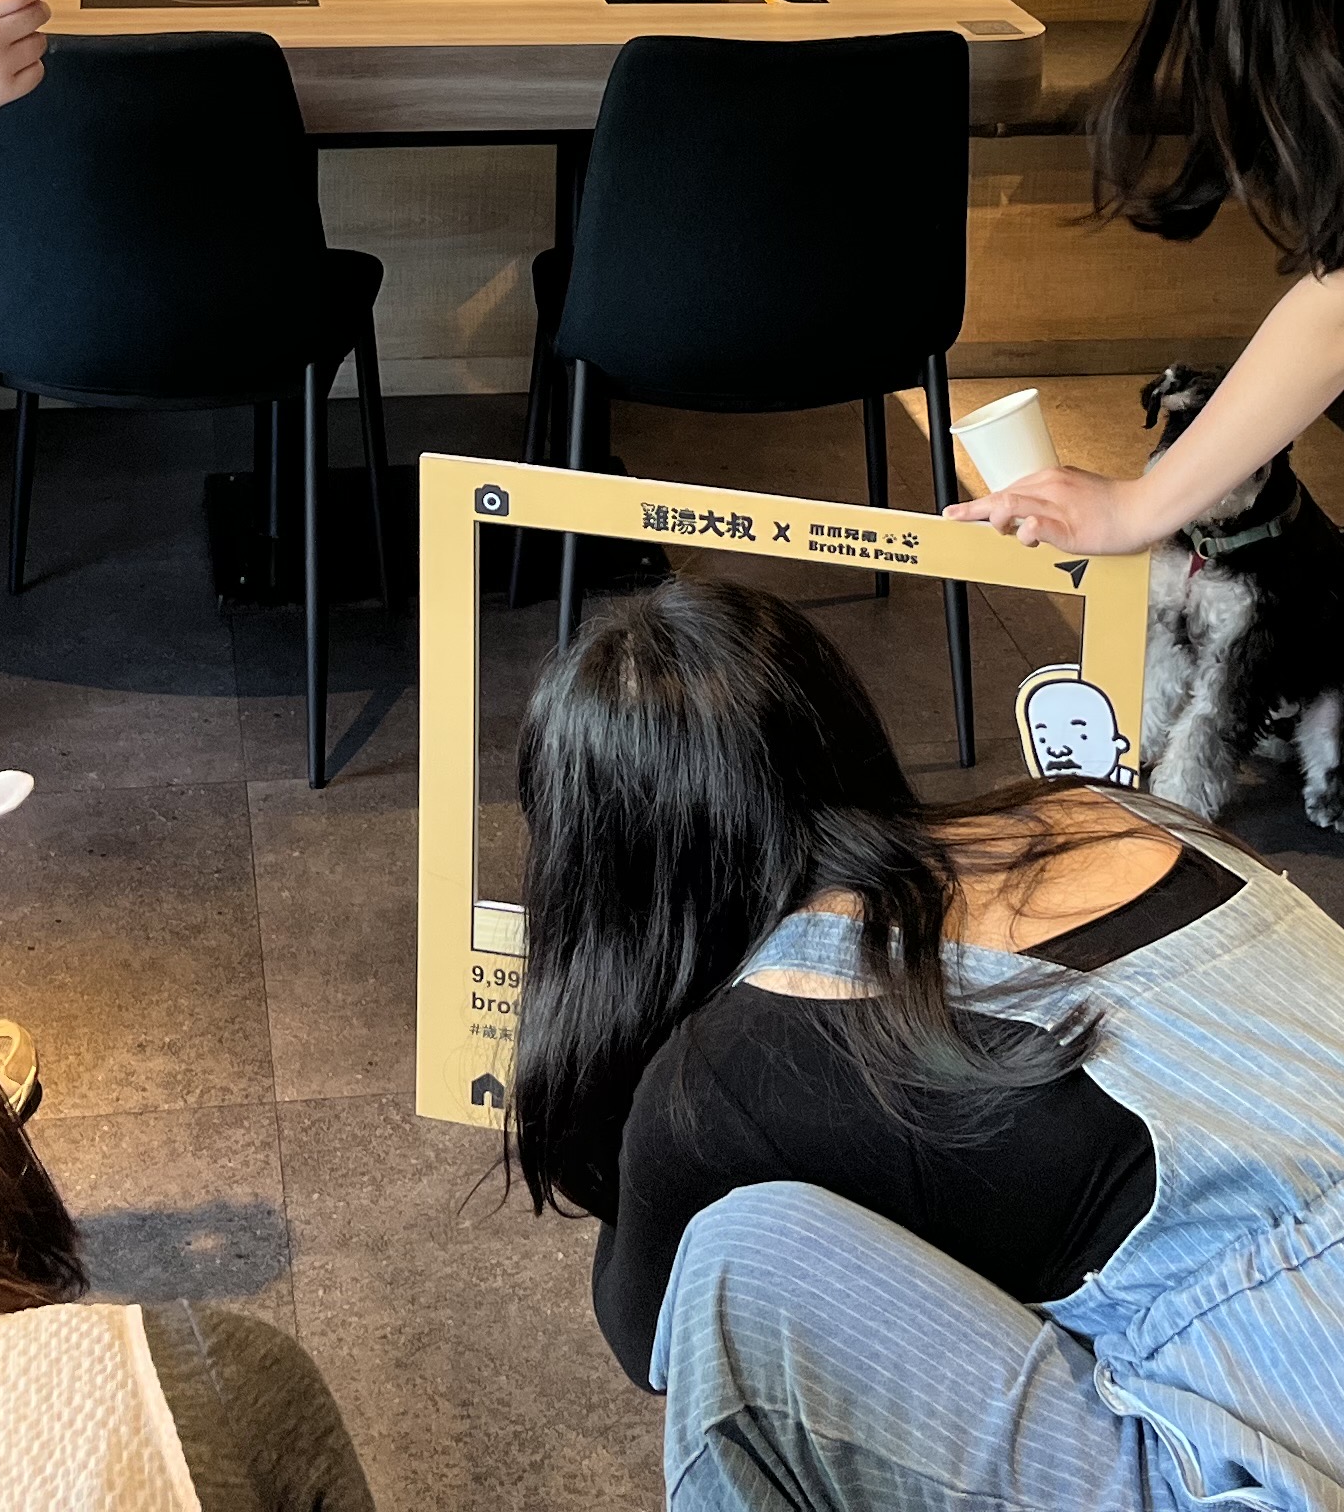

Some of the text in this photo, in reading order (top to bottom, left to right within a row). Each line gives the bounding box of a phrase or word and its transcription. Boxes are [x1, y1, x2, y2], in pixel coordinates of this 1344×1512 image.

[641, 502, 757, 541] 雞湯大叔
[809, 540, 918, 565] Broth & Paws
